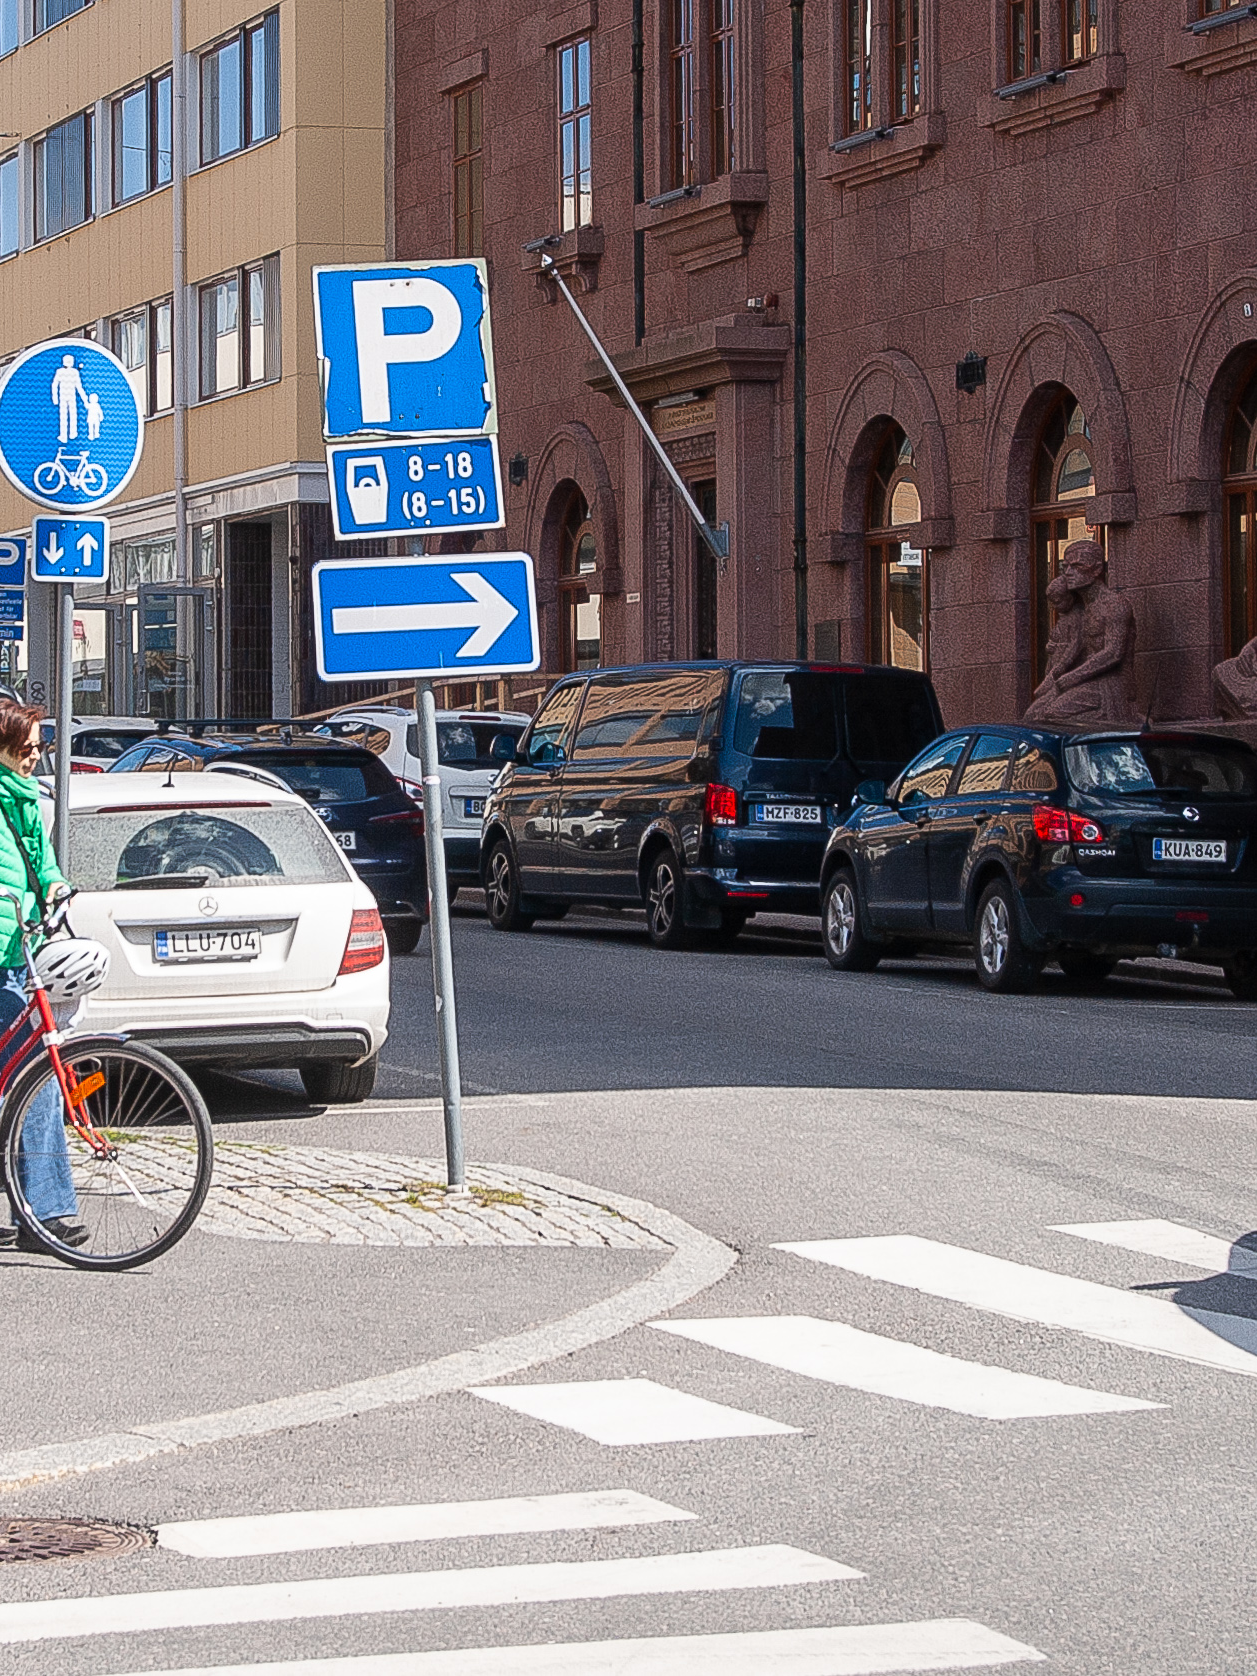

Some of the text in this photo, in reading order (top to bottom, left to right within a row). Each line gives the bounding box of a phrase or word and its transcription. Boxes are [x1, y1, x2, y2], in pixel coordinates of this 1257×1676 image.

[352, 277, 462, 424] P
[408, 451, 473, 482] 8-18
[402, 485, 486, 520] (8-15)
[1163, 841, 1223, 859] KUA-849
[171, 931, 256, 953] LLU-704
